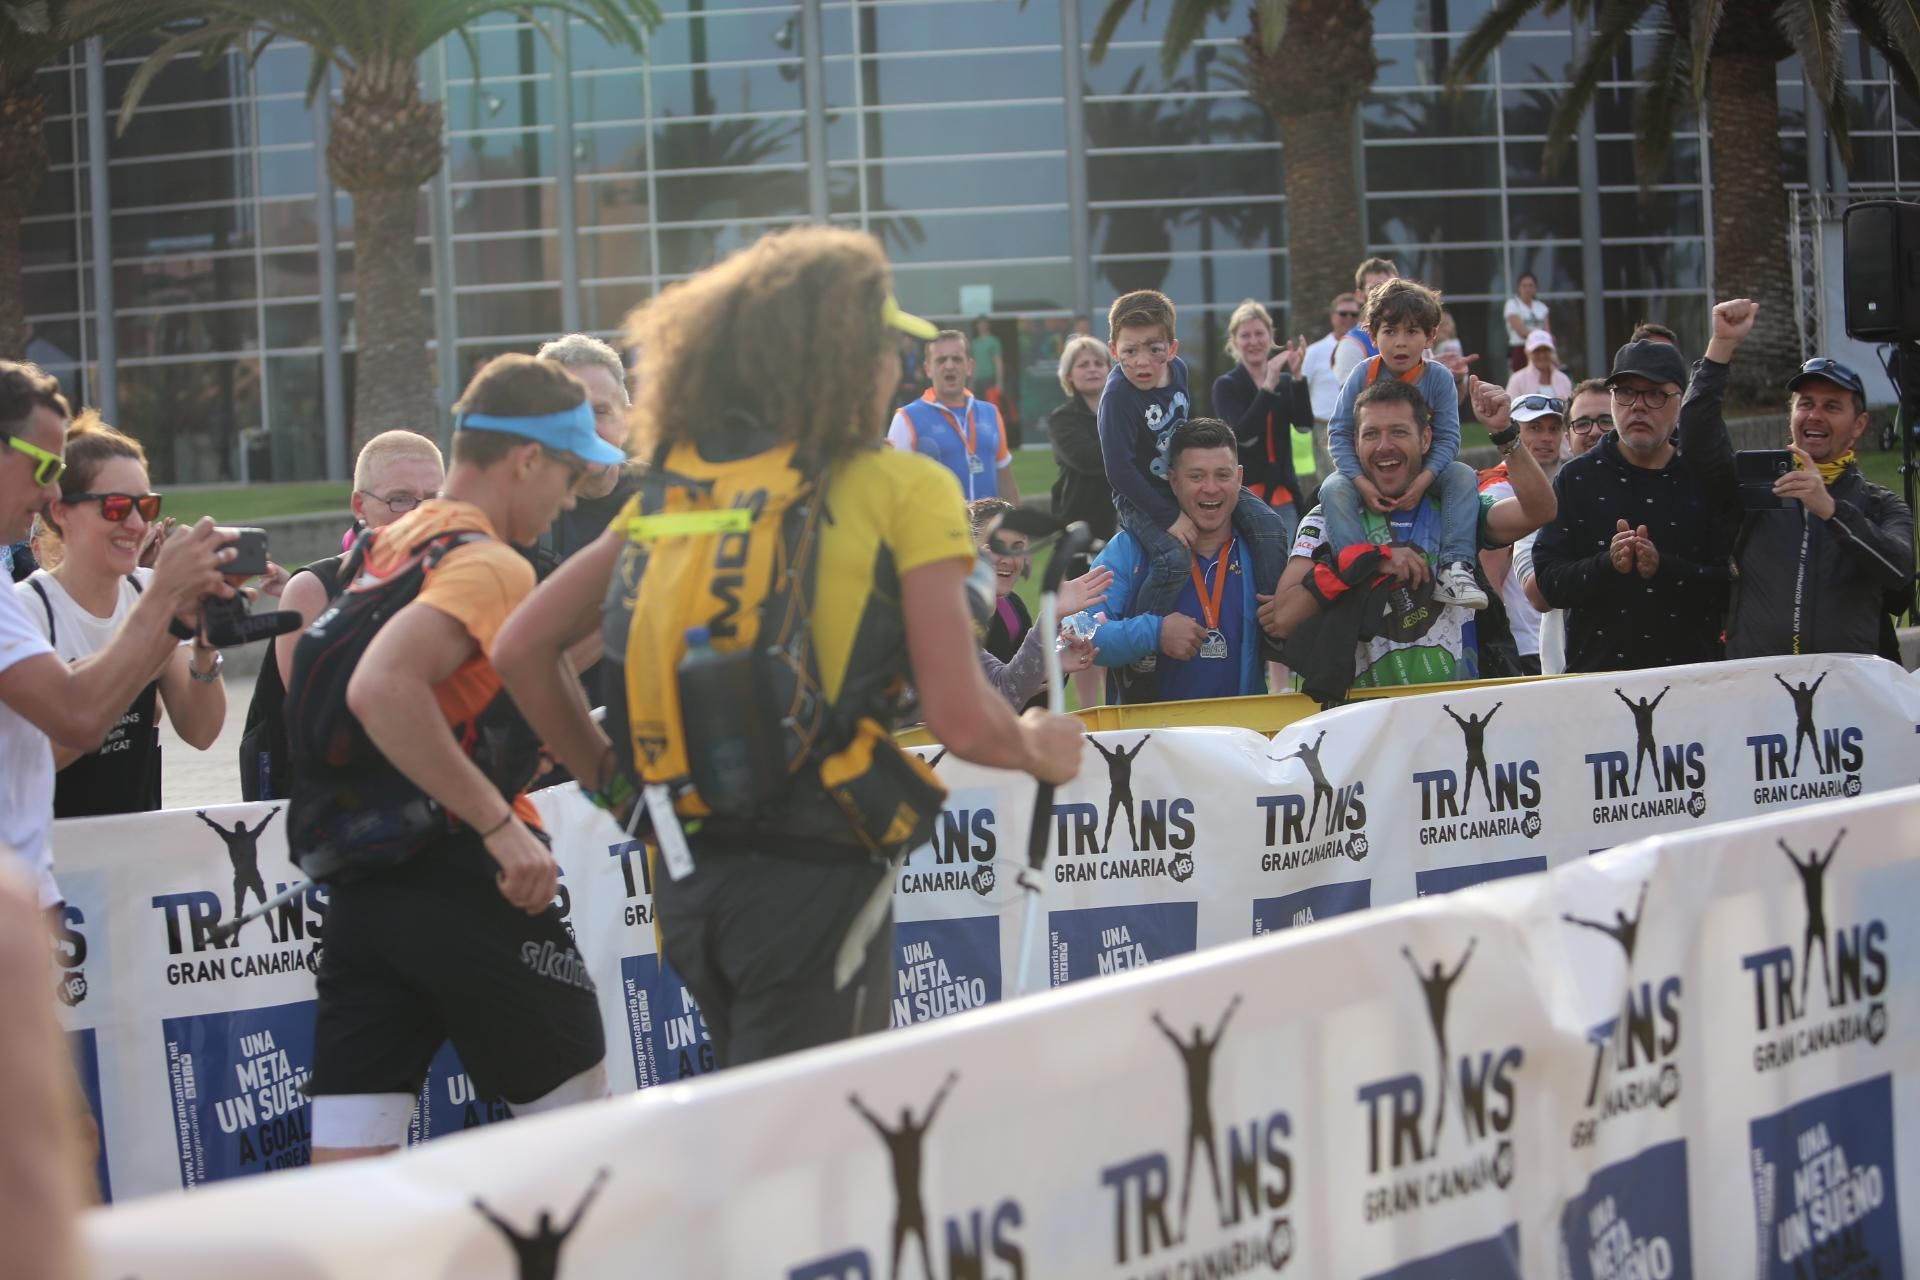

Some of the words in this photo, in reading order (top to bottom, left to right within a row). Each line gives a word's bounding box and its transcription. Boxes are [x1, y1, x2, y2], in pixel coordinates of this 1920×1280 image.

[1402, 606, 1429, 629] JESUS
[1793, 606, 1801, 632] ULTRA
[112, 740, 131, 752] CAT
[1746, 726, 1864, 781] TRANS
[1413, 759, 1542, 821] TRANS
[1585, 742, 1706, 801] TRANS
[1753, 785, 1788, 805] GRAN
[1790, 778, 1843, 801] CANARIA
[1051, 797, 1196, 857] TRANS
[1256, 780, 1367, 847] TRANS
[1593, 804, 1629, 824] GRAN
[1631, 797, 1687, 820] CANARIA
[1419, 825, 1456, 846] GRAN
[1460, 816, 1521, 841] CANARIA
[1055, 861, 1097, 882] GRAN
[1100, 857, 1167, 880] CANARIA
[1261, 853, 1300, 872] GRAN
[1301, 840, 1345, 866] CANARIA
[902, 870, 972, 894] CANARIA
[152, 880, 330, 955] TRANS
[903, 940, 934, 964] UNA
[1101, 925, 1131, 948] UNA
[167, 958, 226, 986] GRAN
[230, 949, 305, 979] CANARIA
[898, 958, 952, 996] META
[1097, 942, 1149, 977] META
[1743, 919, 1888, 1031] TRANS
[916, 975, 986, 1023] SUEÑO
[240, 1030, 275, 1058] UNA
[664, 1014, 697, 1050] UN
[235, 1049, 292, 1094] META
[215, 1094, 257, 1134] UN
[239, 1130, 257, 1168] A
[1101, 1111, 1294, 1265] TRANS
[1793, 1144, 1850, 1210] META
[1777, 1209, 1812, 1264] UN
[1808, 1163, 1885, 1243] SUEÑO
